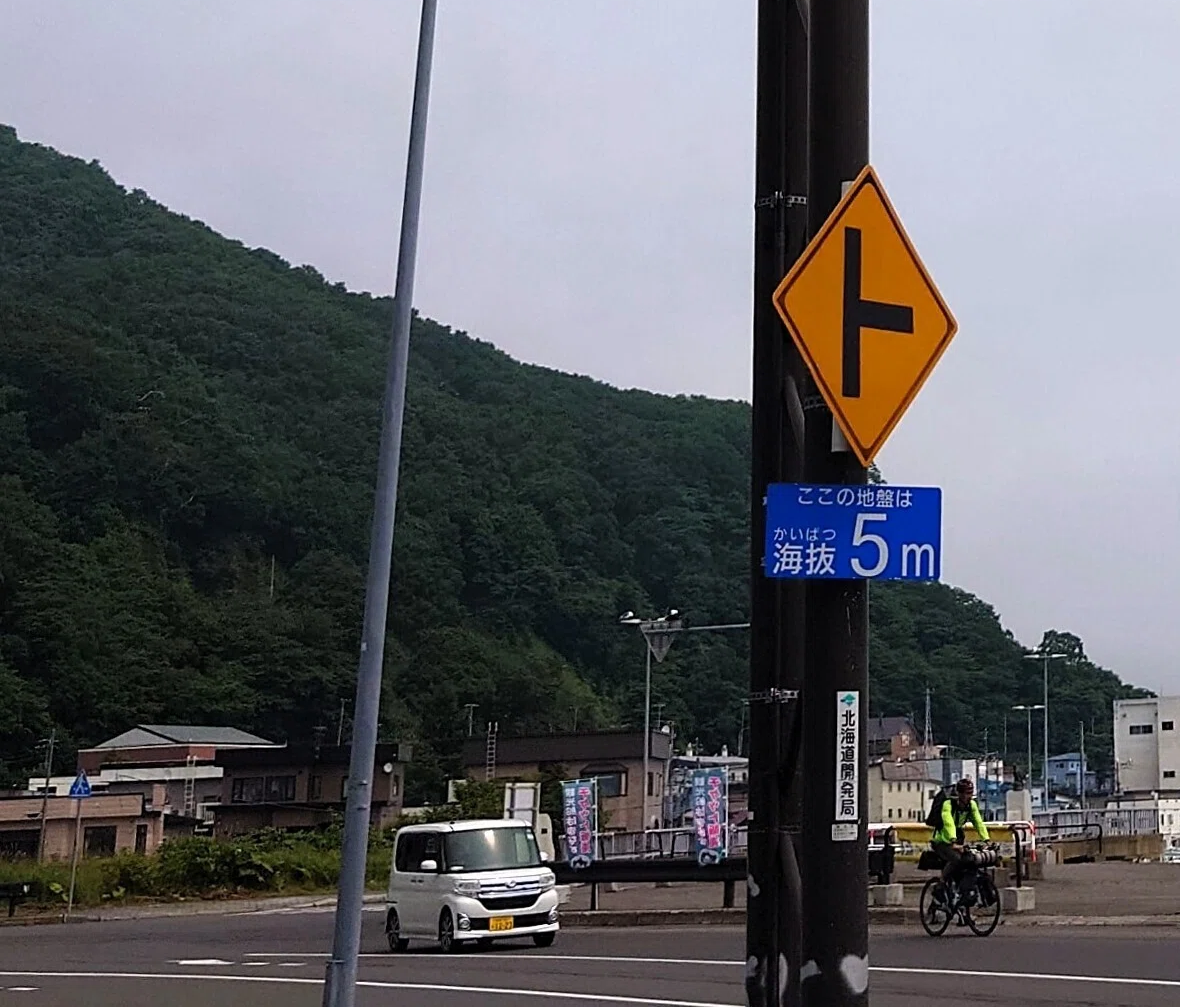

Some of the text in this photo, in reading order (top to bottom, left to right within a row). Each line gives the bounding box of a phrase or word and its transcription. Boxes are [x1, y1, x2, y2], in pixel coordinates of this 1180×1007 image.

[798, 488, 913, 508] ここの地盤は
[840, 709, 856, 816] 北海道開発局
